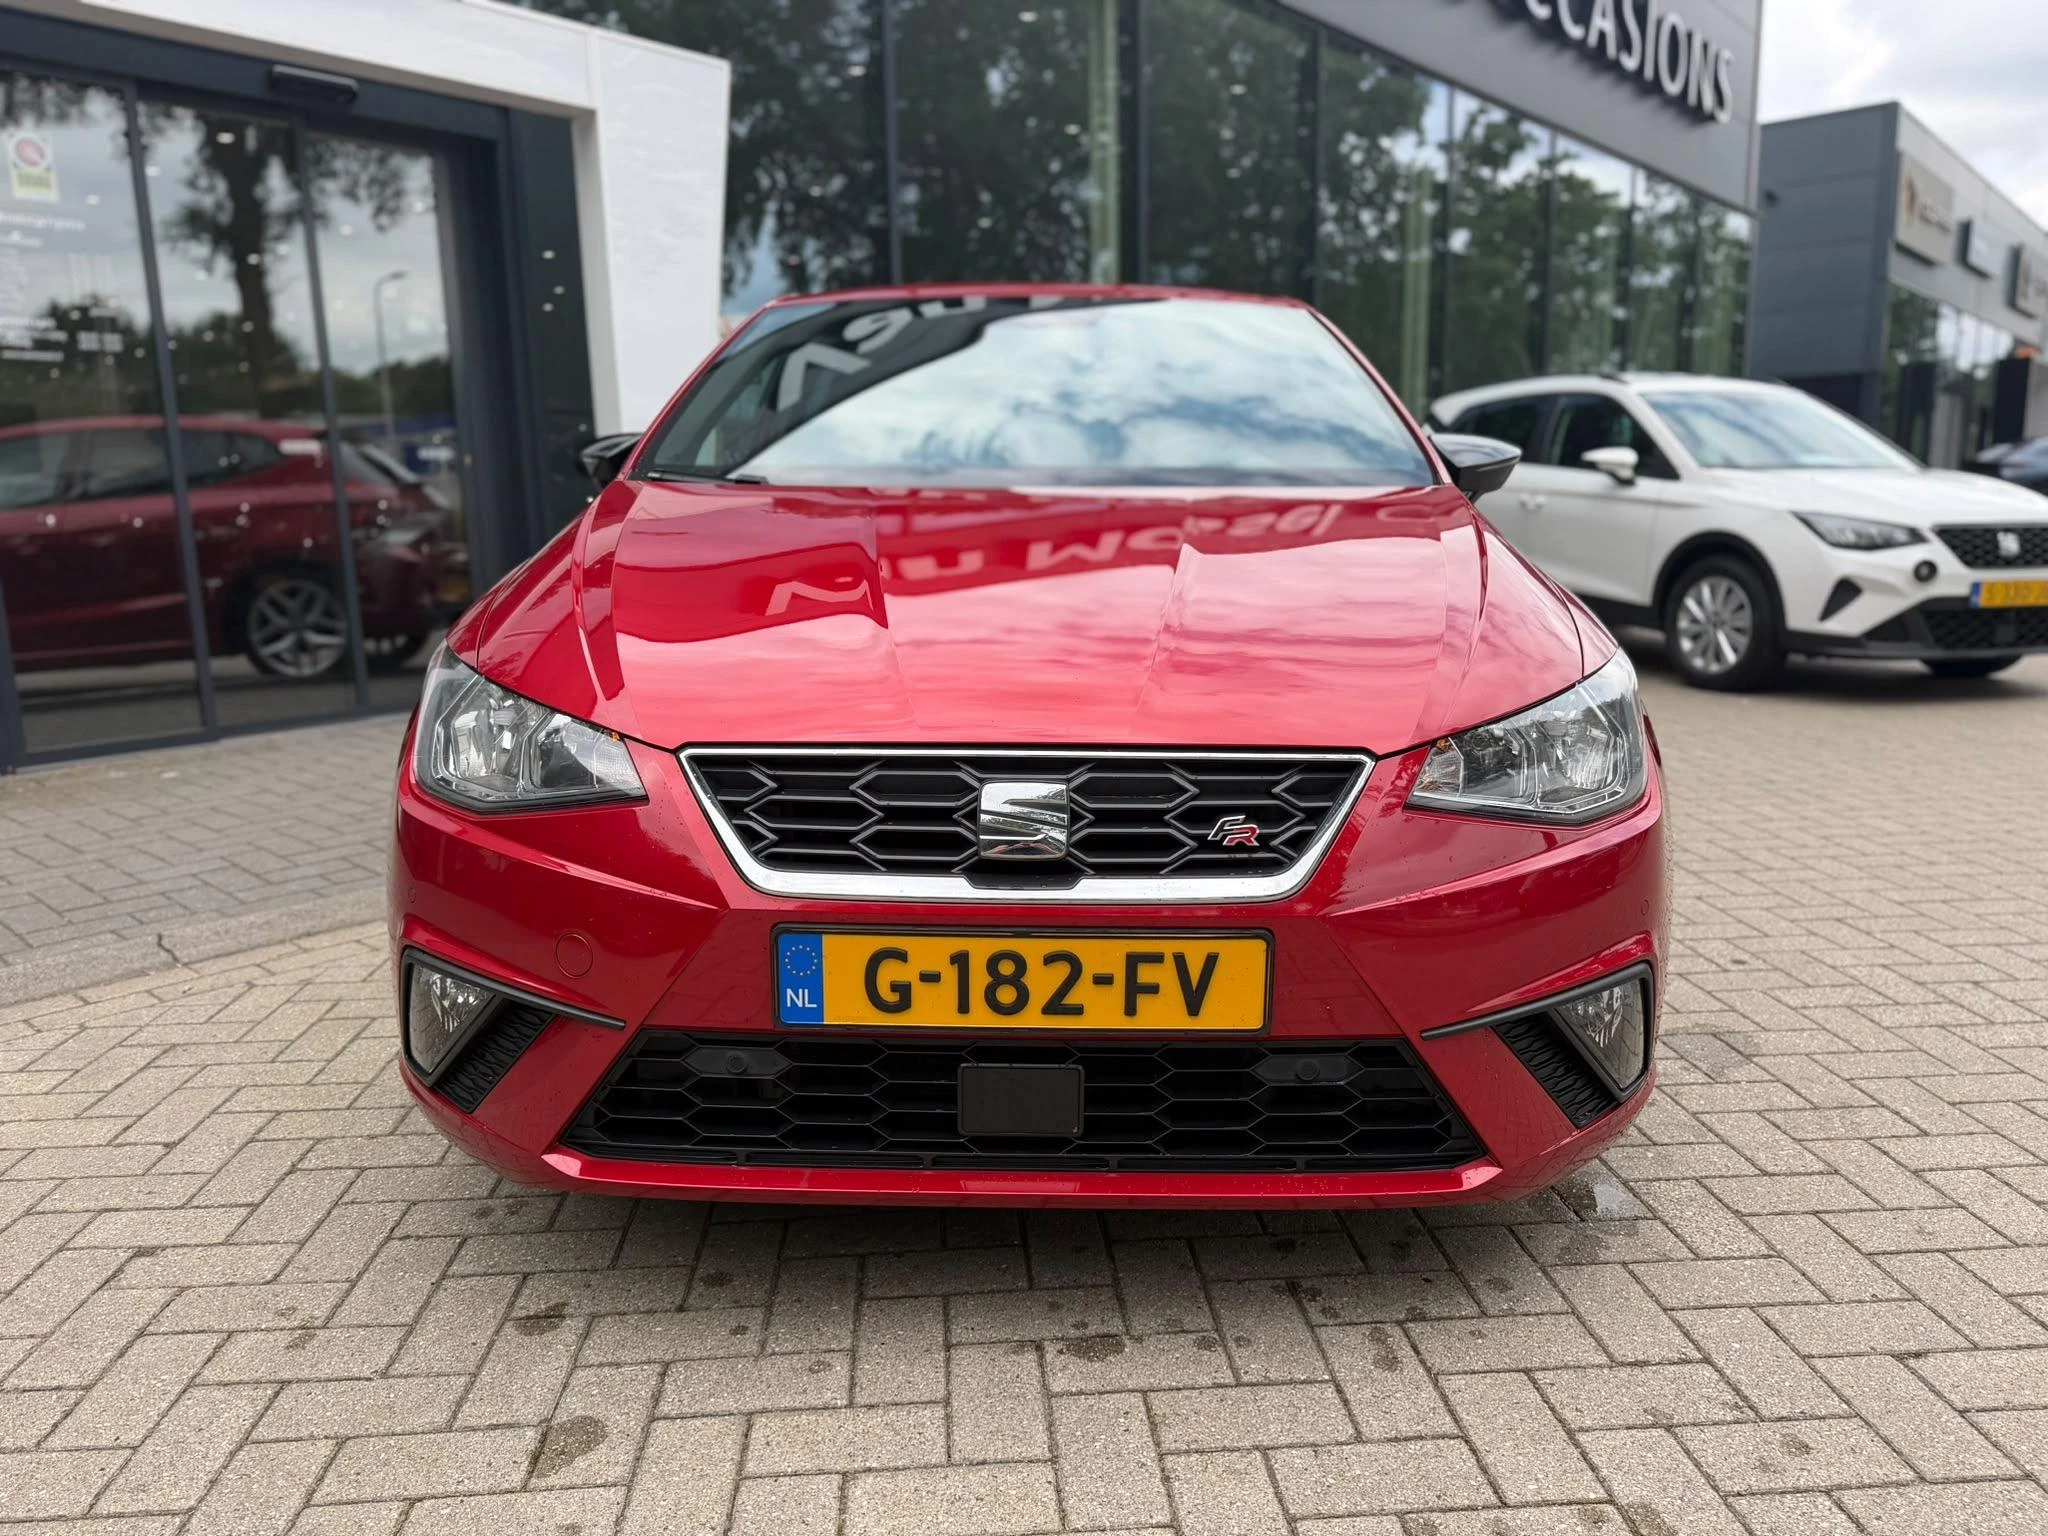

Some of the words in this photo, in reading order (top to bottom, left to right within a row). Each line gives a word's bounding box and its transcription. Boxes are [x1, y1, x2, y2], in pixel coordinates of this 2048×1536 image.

[1524, 0, 1734, 124] ASIONS
[1207, 815, 1260, 847] FR
[785, 988, 818, 1008] NL
[864, 946, 1220, 1018] G-182-FV
